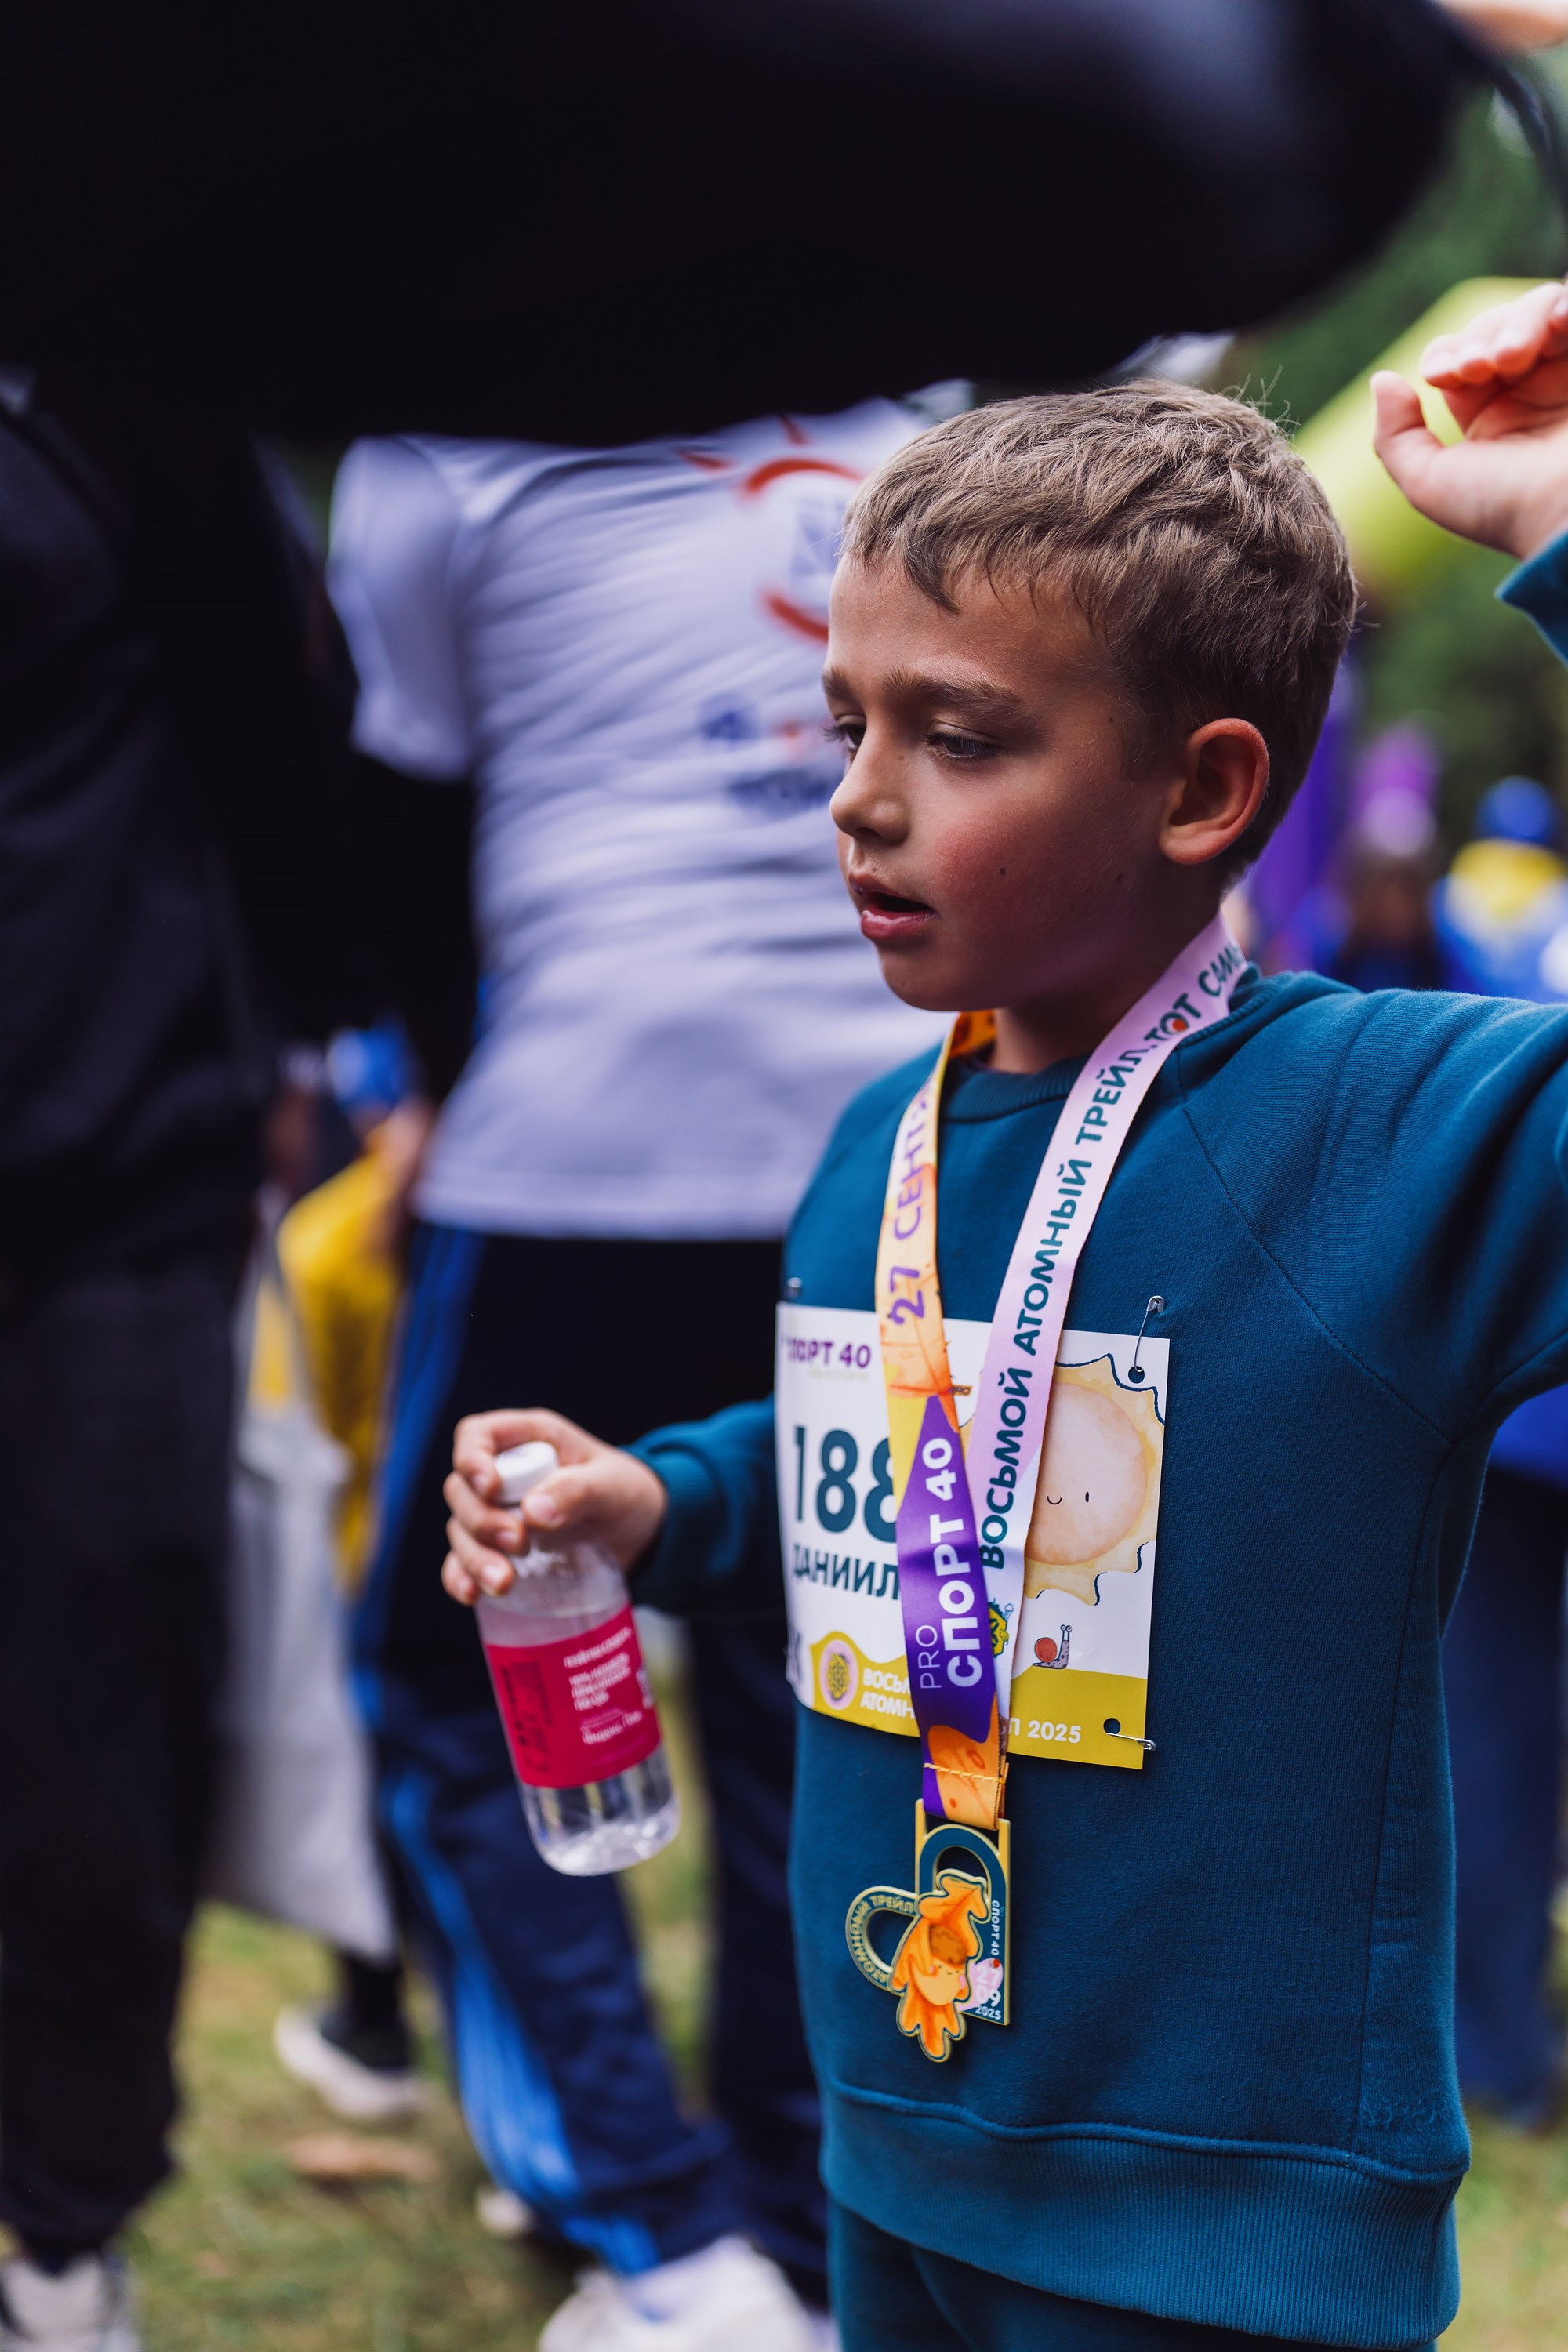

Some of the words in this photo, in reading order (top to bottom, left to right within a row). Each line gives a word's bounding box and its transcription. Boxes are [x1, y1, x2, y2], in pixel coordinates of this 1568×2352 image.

[893, 1102, 926, 1241] СЕНТ
[889, 1265, 926, 1326] 27
[979, 1369, 1033, 1570] ВОСЬМОЙ
[1014, 1159, 1093, 1357] АТОМНЫЙ
[1143, 993, 1201, 1041] ТОТ
[782, 1336, 833, 1366] ПОРТ
[840, 1342, 872, 1369] 40
[793, 1424, 897, 1543] 188
[922, 1438, 957, 1501] 40
[930, 1514, 982, 1688] СПОРТ
[915, 1624, 942, 1690] PRO
[1028, 1720, 1082, 1744] 2025
[991, 1900, 1000, 1940] СПОРТ
[991, 1941, 1000, 1955] 40
[975, 1984, 1001, 2008] 09
[976, 1965, 1000, 1987] 27
[975, 2005, 1002, 2020] 2025
